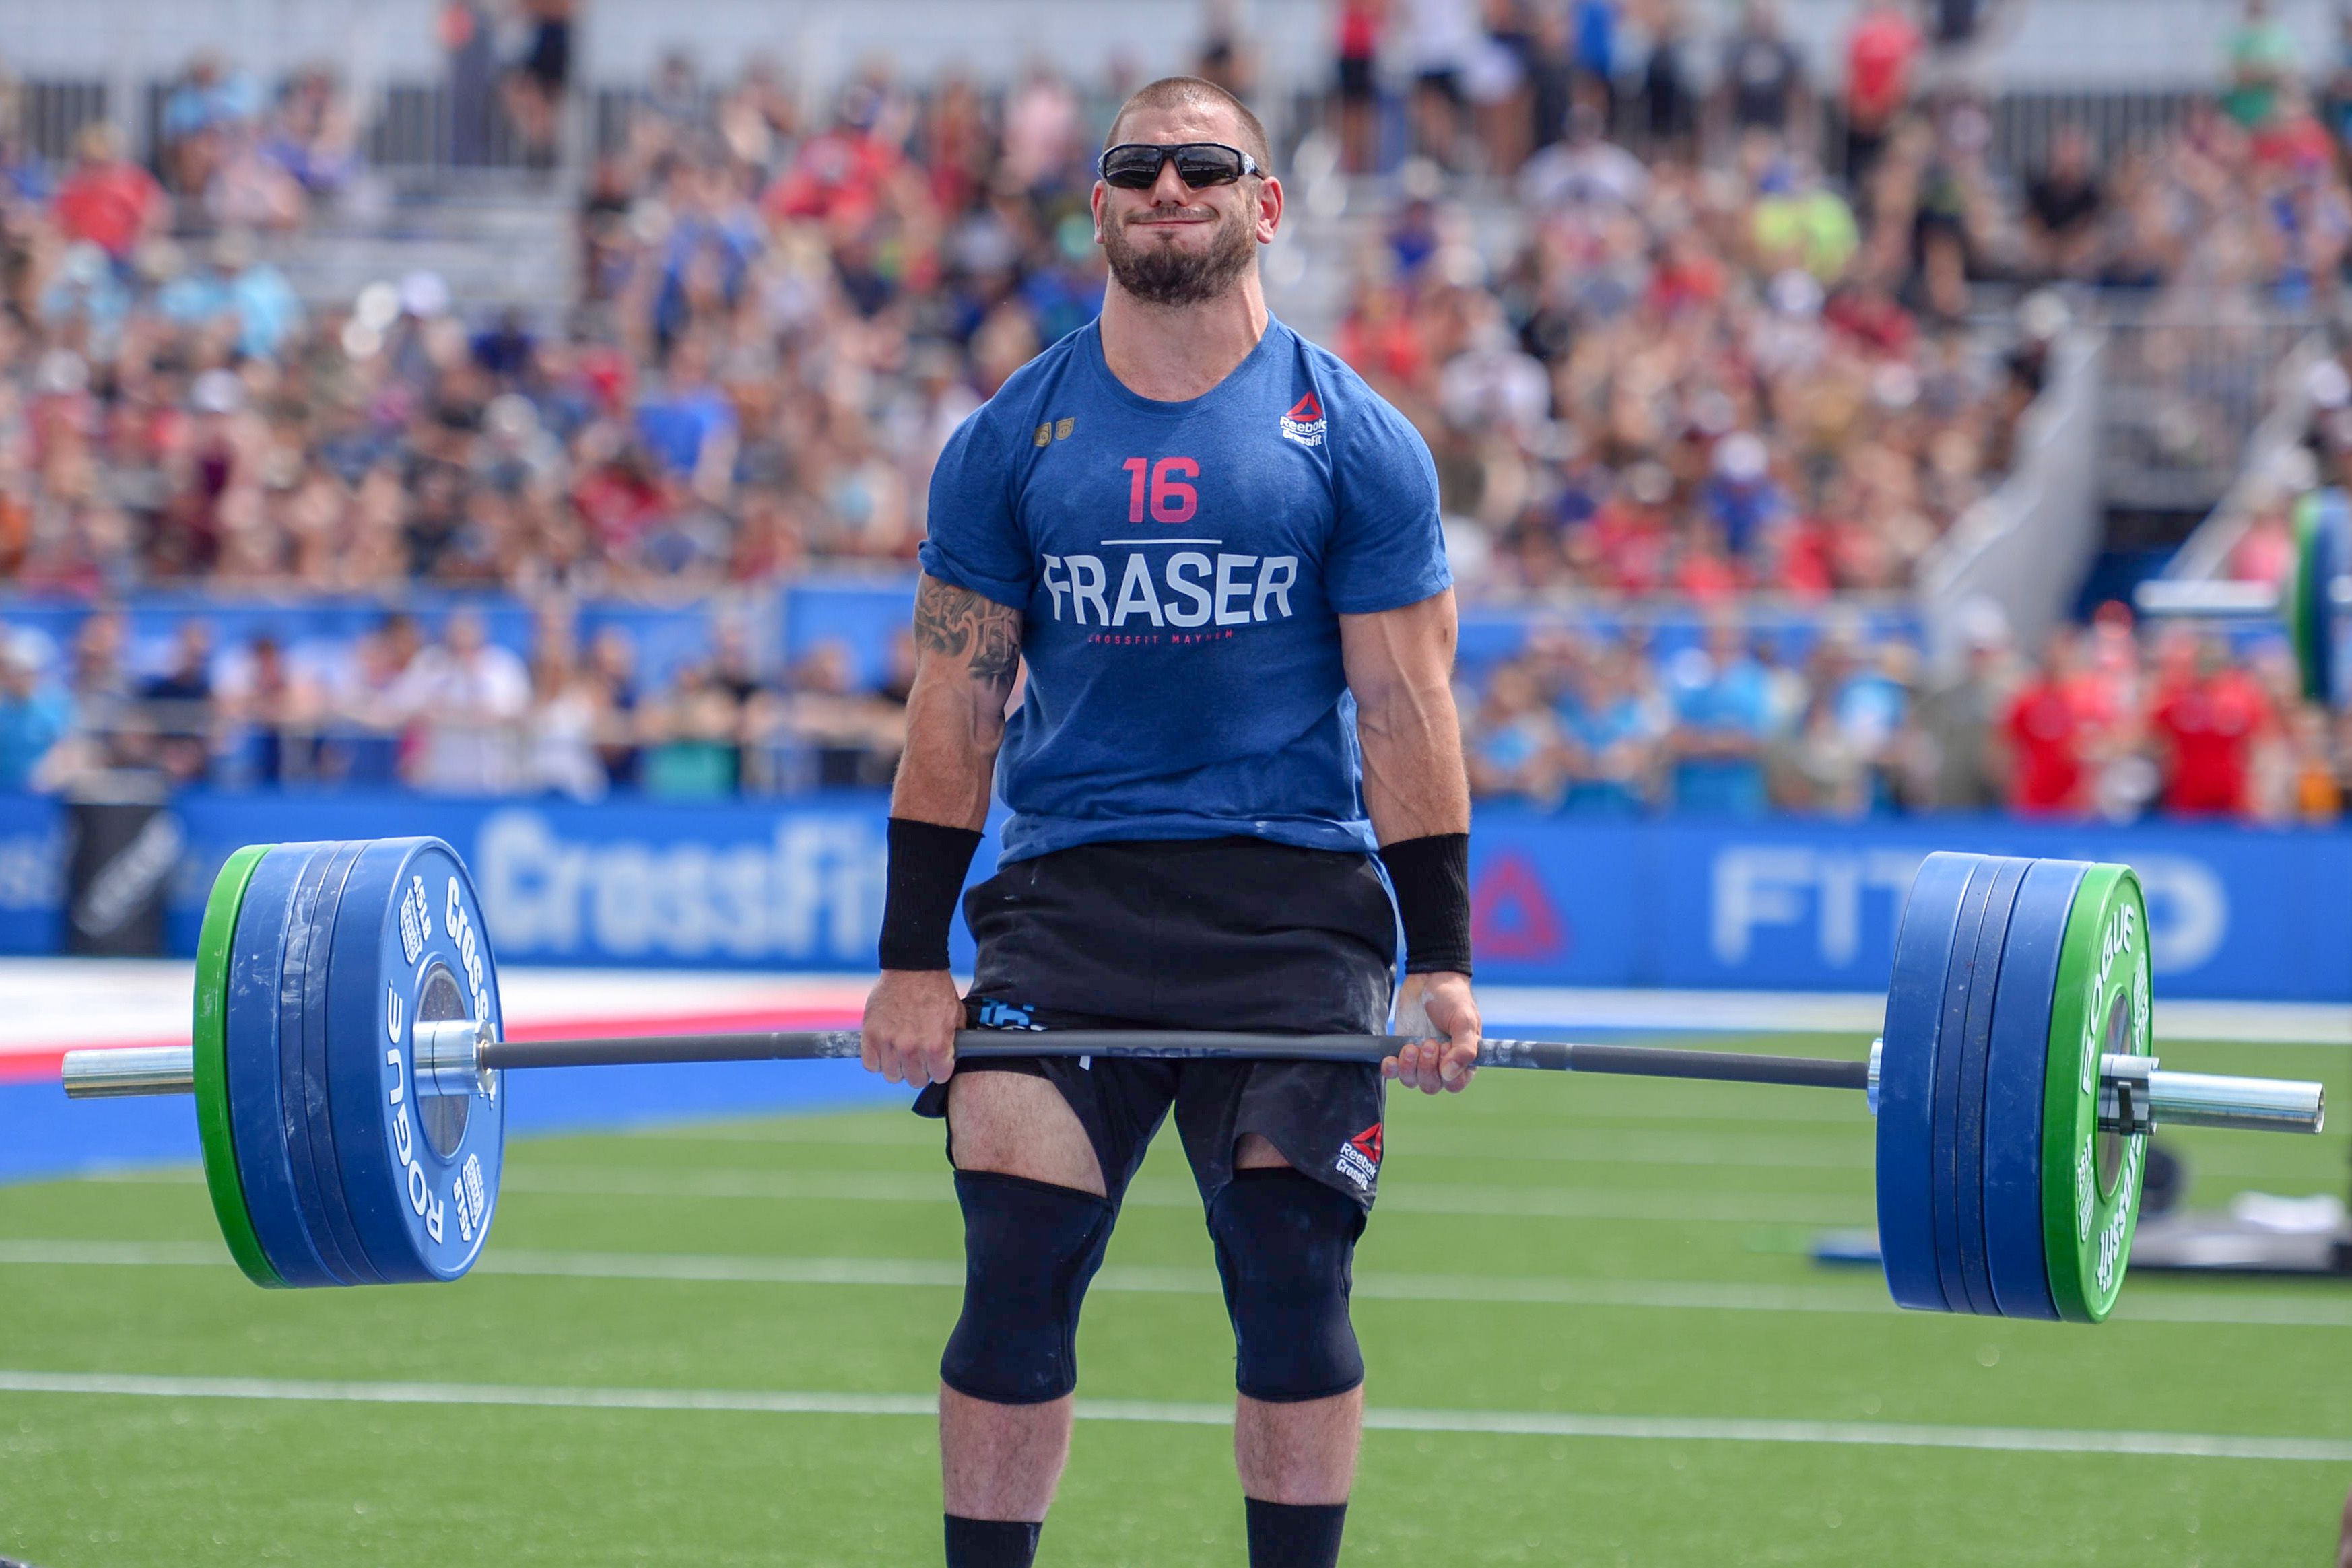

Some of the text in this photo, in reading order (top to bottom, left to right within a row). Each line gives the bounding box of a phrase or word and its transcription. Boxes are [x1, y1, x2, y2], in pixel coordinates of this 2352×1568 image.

[1280, 416, 1327, 432] Reebok
[1283, 429, 1322, 446] CrossFit
[1122, 457, 1200, 523] 16
[1042, 551, 1298, 627] FRASER
[1087, 634, 1159, 646] CROSSFIT
[475, 813, 886, 959] CrossFi
[2082, 903, 2135, 1095] ROGUE
[387, 987, 444, 1244] ROGUE
[1335, 1159, 1368, 1191] CrossFit
[1339, 1142, 1376, 1178] Reebok
